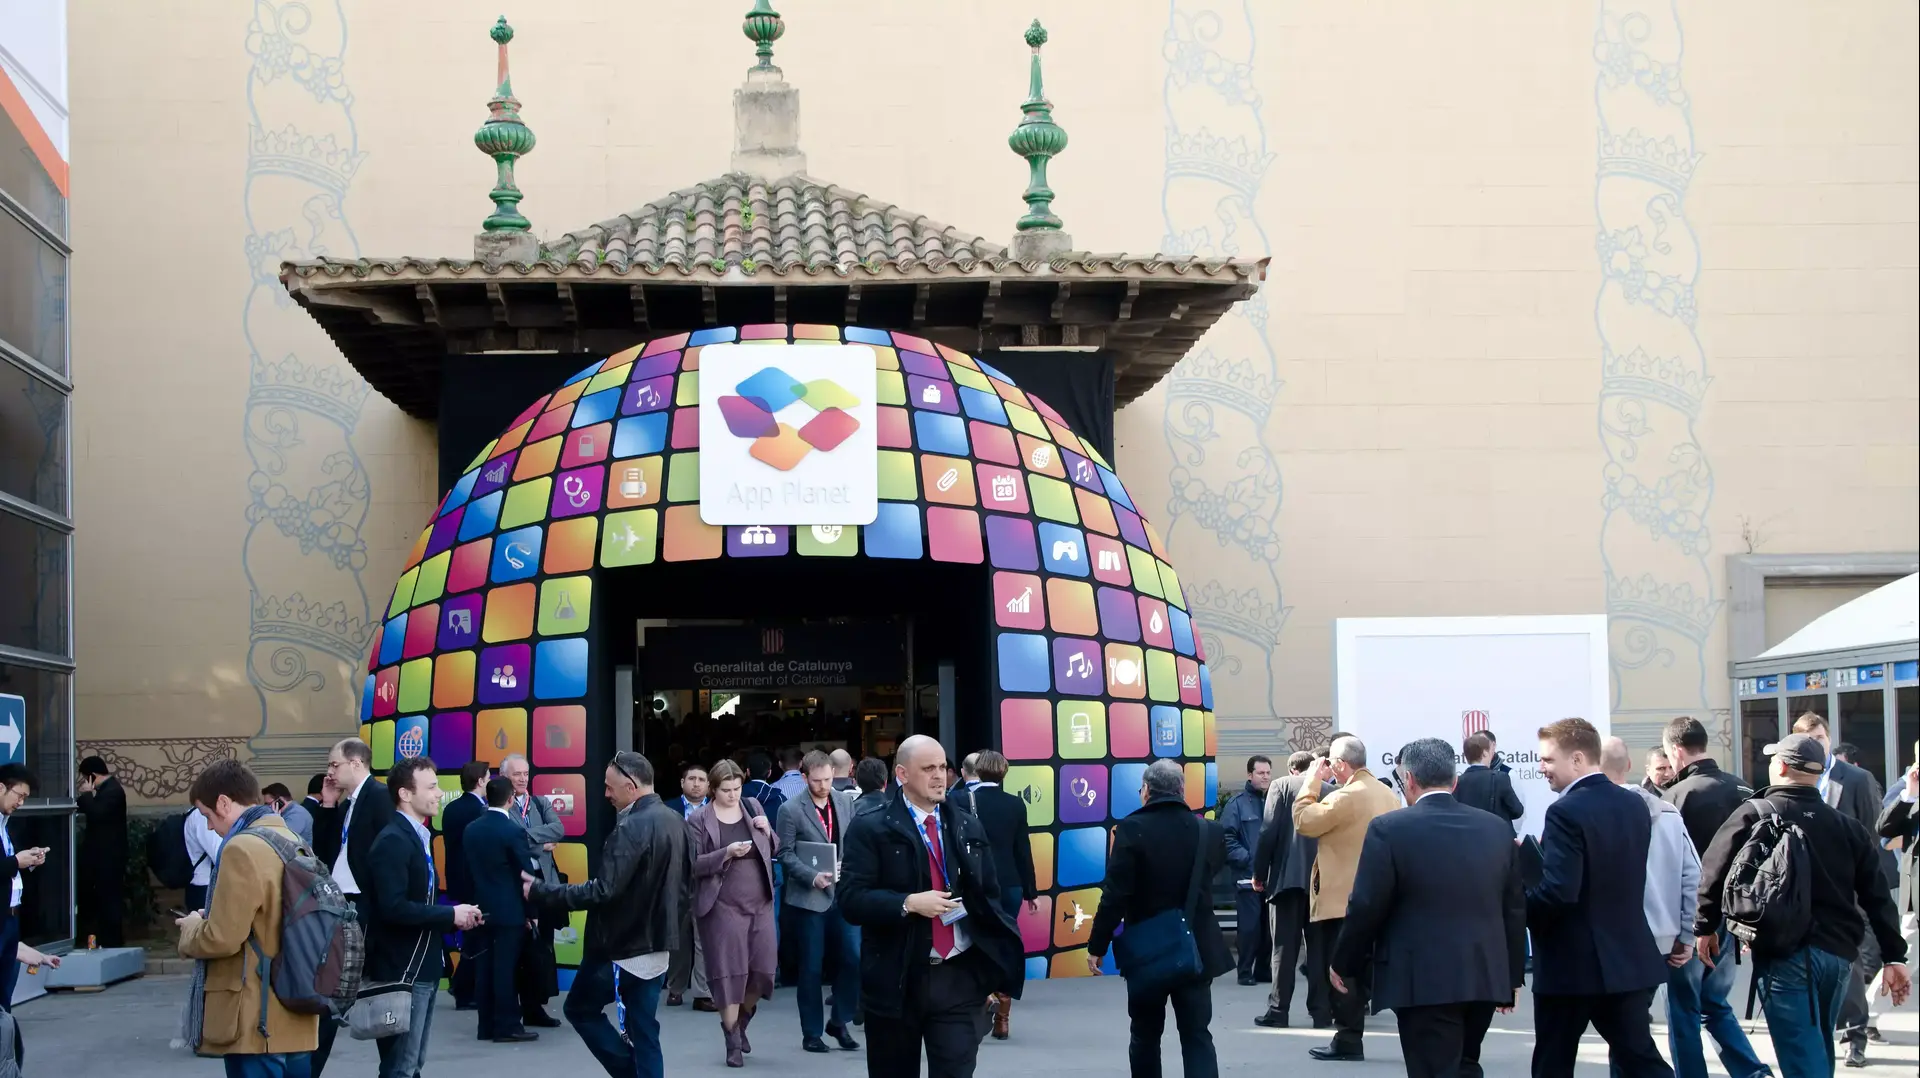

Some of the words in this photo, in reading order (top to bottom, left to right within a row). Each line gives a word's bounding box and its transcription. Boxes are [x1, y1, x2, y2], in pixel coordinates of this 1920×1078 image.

[726, 481, 772, 511] App
[781, 477, 851, 506] Planet
[693, 661, 765, 674] Generalitat
[768, 660, 785, 672] de
[788, 659, 853, 672] Catalunya
[700, 674, 773, 687] Government
[776, 673, 788, 685] of
[791, 673, 847, 685] Catalonia
